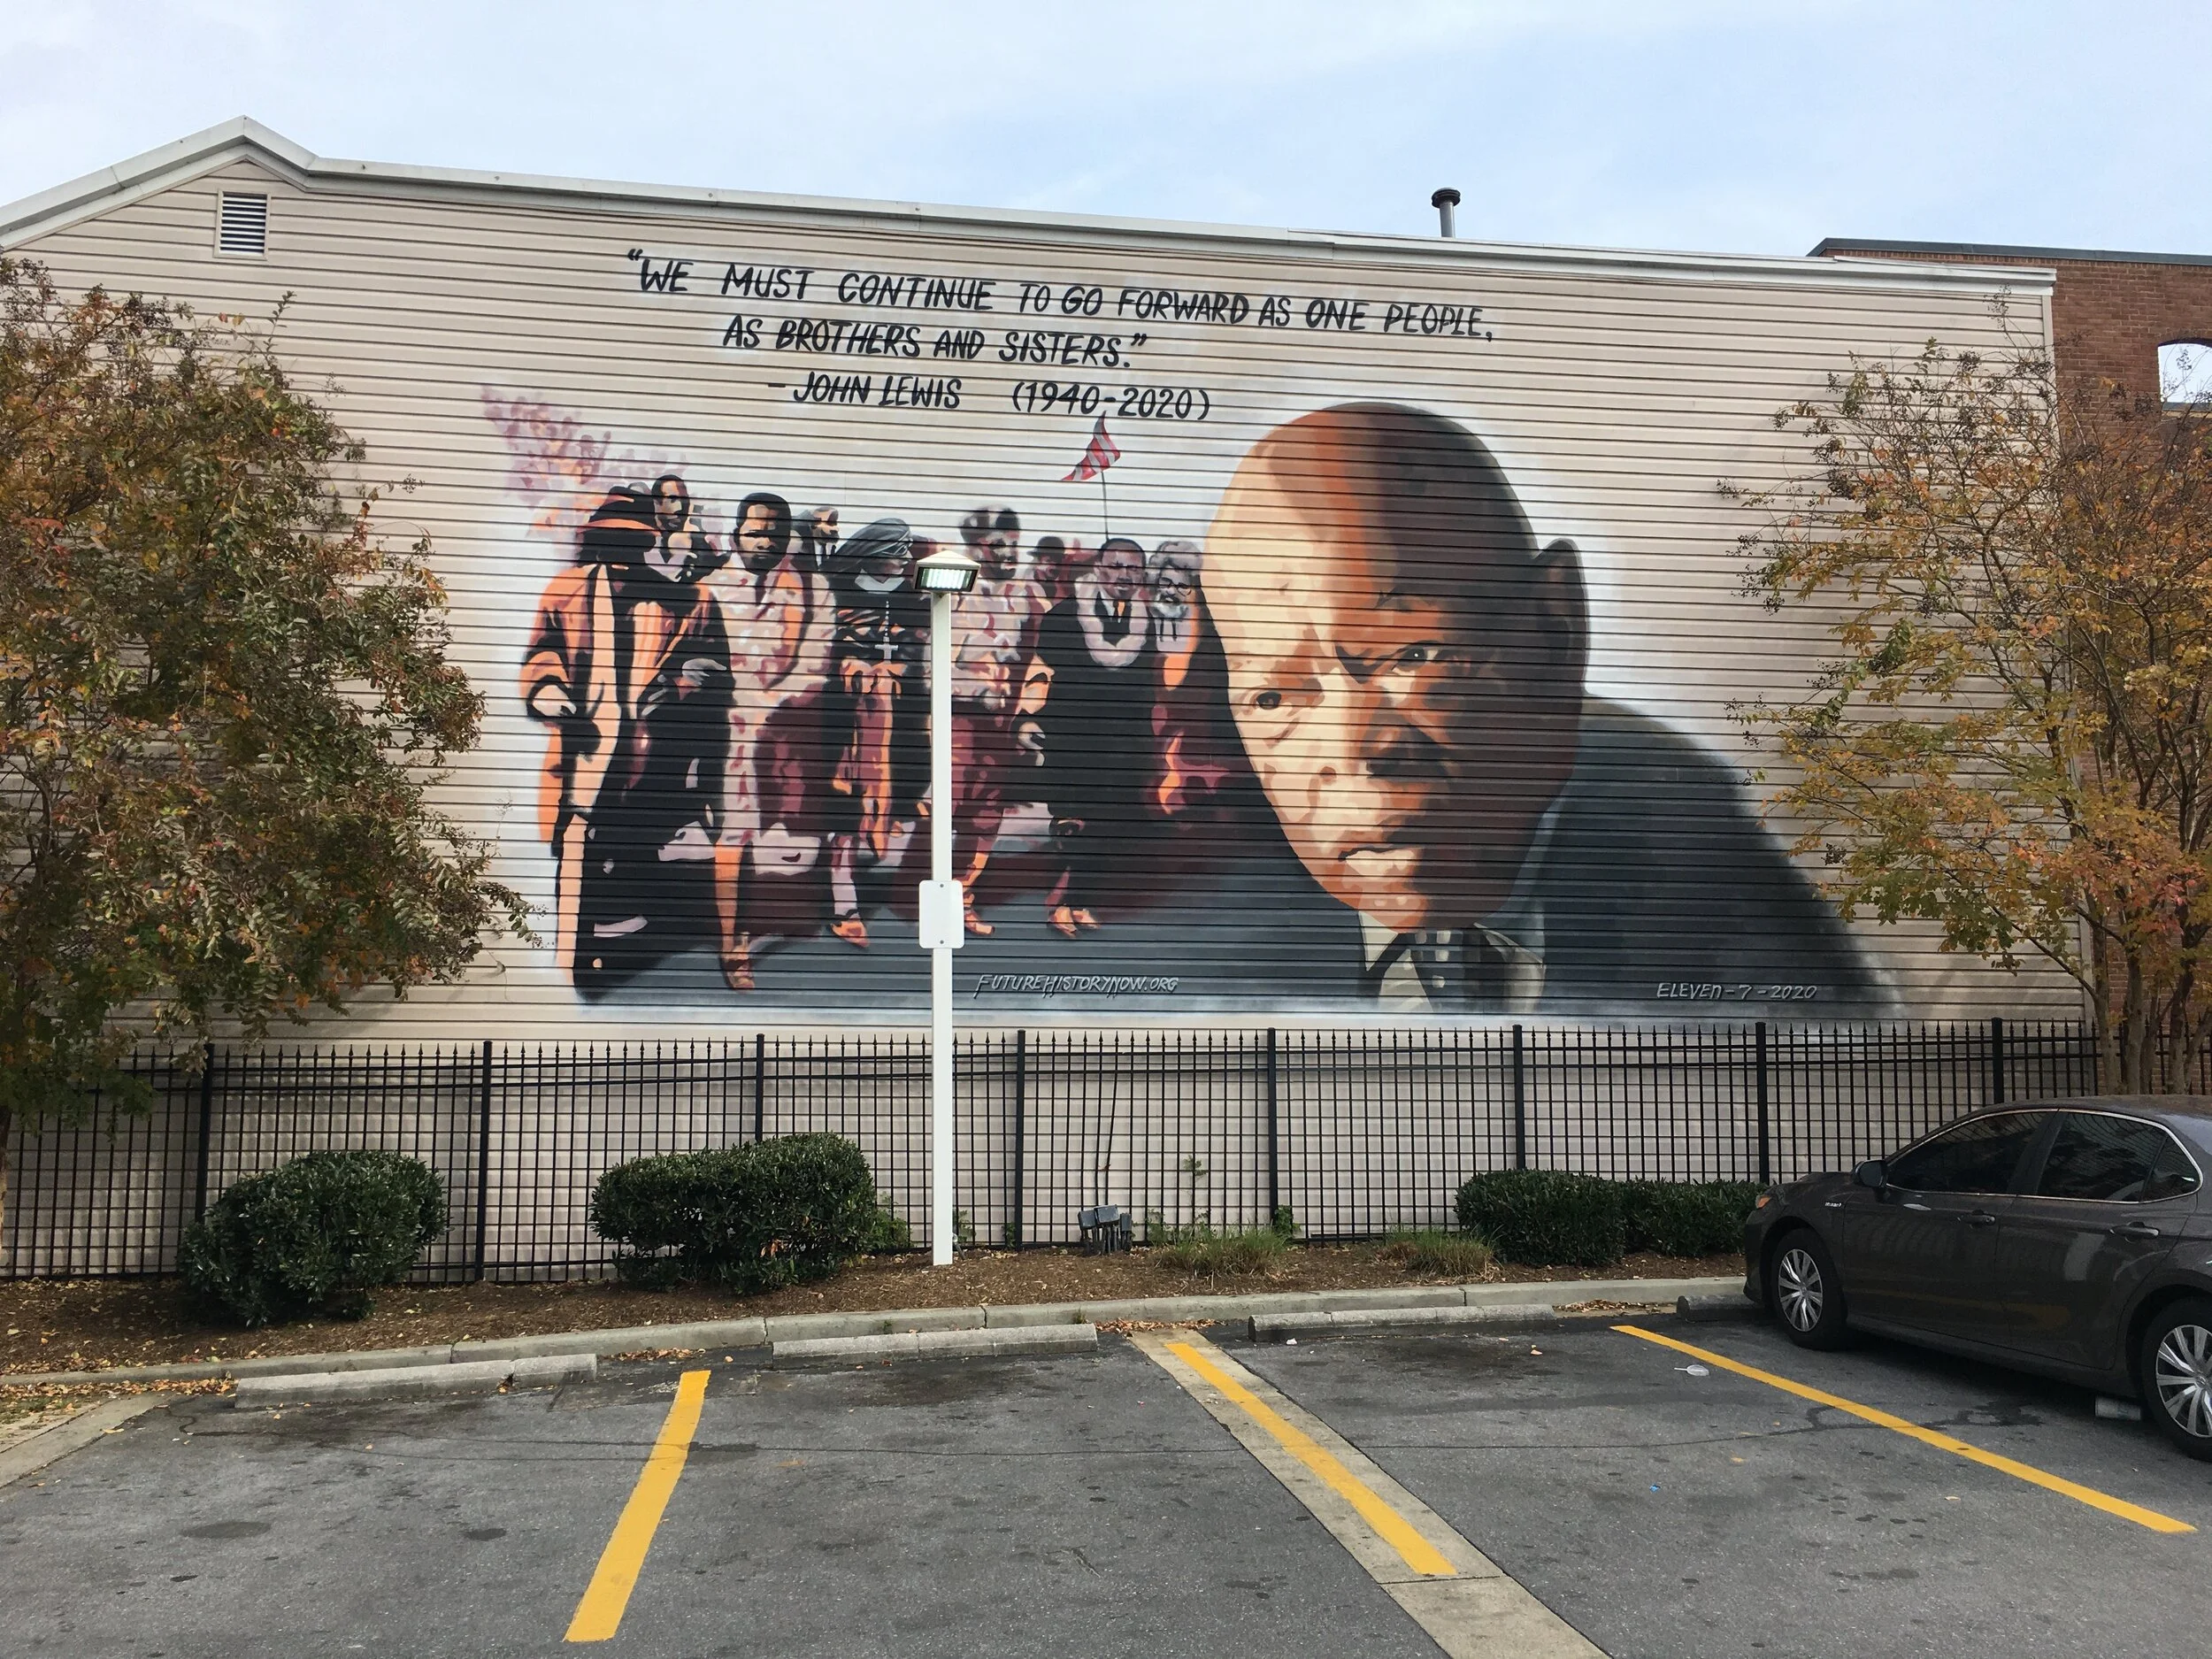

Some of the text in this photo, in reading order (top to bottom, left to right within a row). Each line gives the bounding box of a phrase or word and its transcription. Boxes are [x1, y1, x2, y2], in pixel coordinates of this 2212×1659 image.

[720, 264, 815, 299] MUST
[838, 273, 996, 311] CONTINUE
[1018, 283, 1051, 313] TO
[1062, 284, 1103, 316] GO
[1118, 290, 1249, 324] FORWARD
[1258, 296, 1292, 327] AS
[1306, 299, 1370, 331] ONE
[723, 313, 763, 348] AS
[775, 319, 921, 357] BROTHERS
[933, 330, 985, 359] AND
[879, 374, 962, 409] LEWIS
[1012, 380, 1210, 420] (1940-2020)
